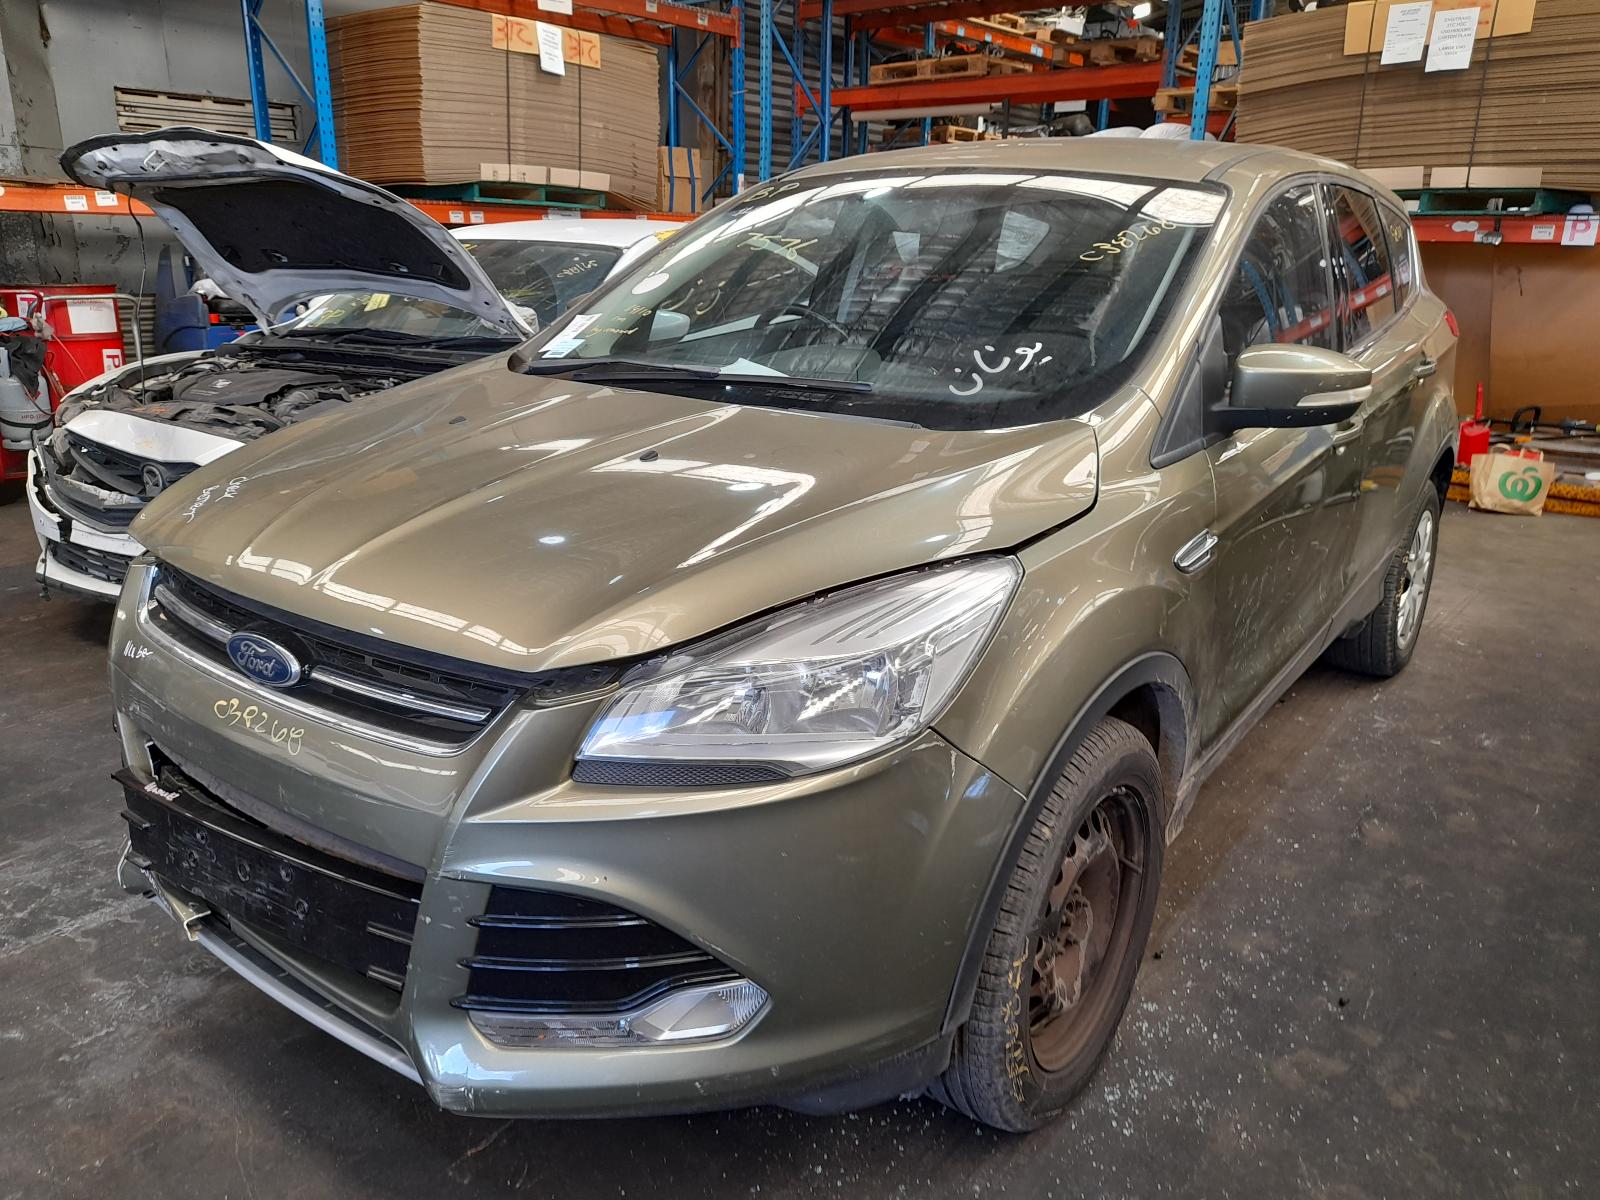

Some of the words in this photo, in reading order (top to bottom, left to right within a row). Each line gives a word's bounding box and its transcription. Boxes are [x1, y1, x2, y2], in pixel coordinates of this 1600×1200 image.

[1569, 220, 1592, 241] P
[105, 354, 121, 368] P
[236, 641, 277, 678] Ford
